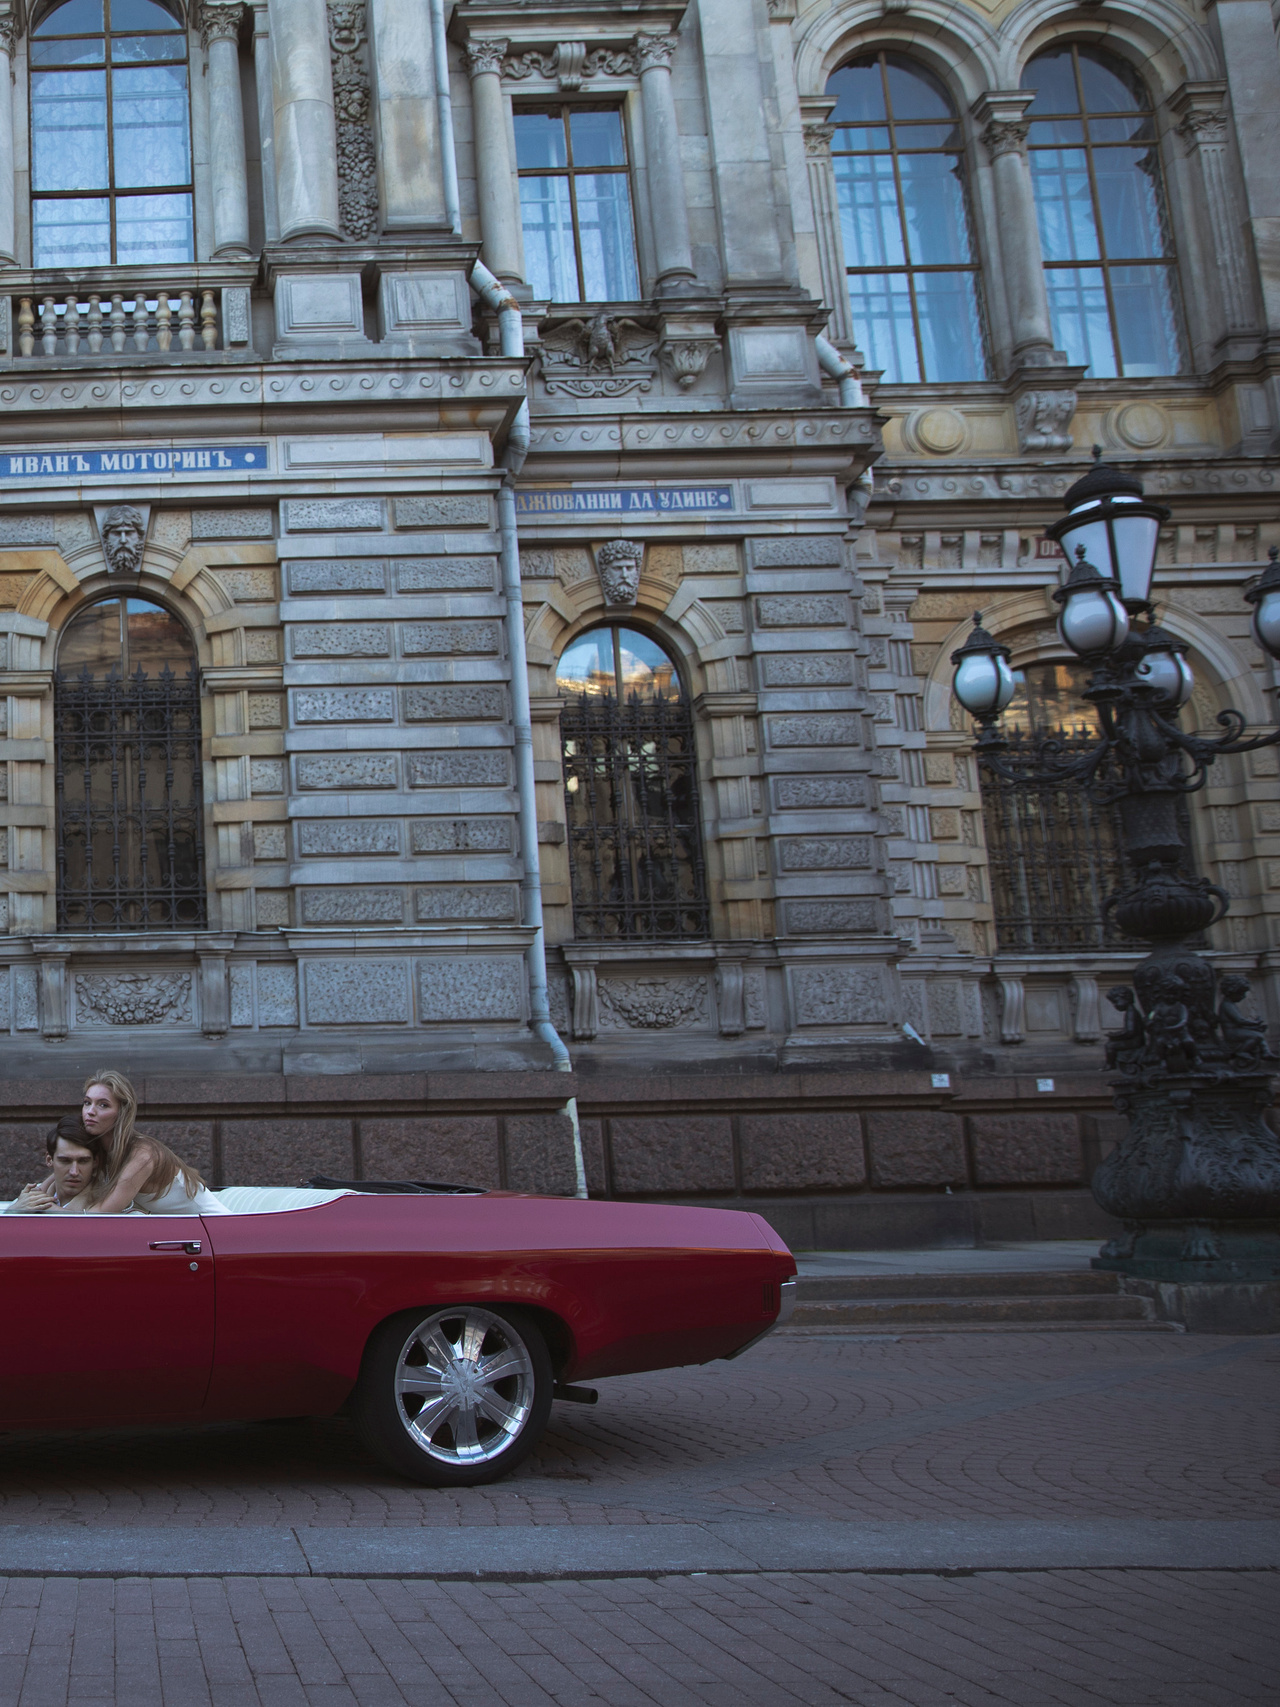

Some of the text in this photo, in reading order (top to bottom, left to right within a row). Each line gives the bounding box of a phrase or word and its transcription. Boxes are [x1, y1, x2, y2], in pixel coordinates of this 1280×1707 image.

[9, 451, 232, 474] ИВАНЪ МОТОРИНЪ
[629, 491, 653, 509] ДА
[659, 491, 719, 508] УДИНЕ
